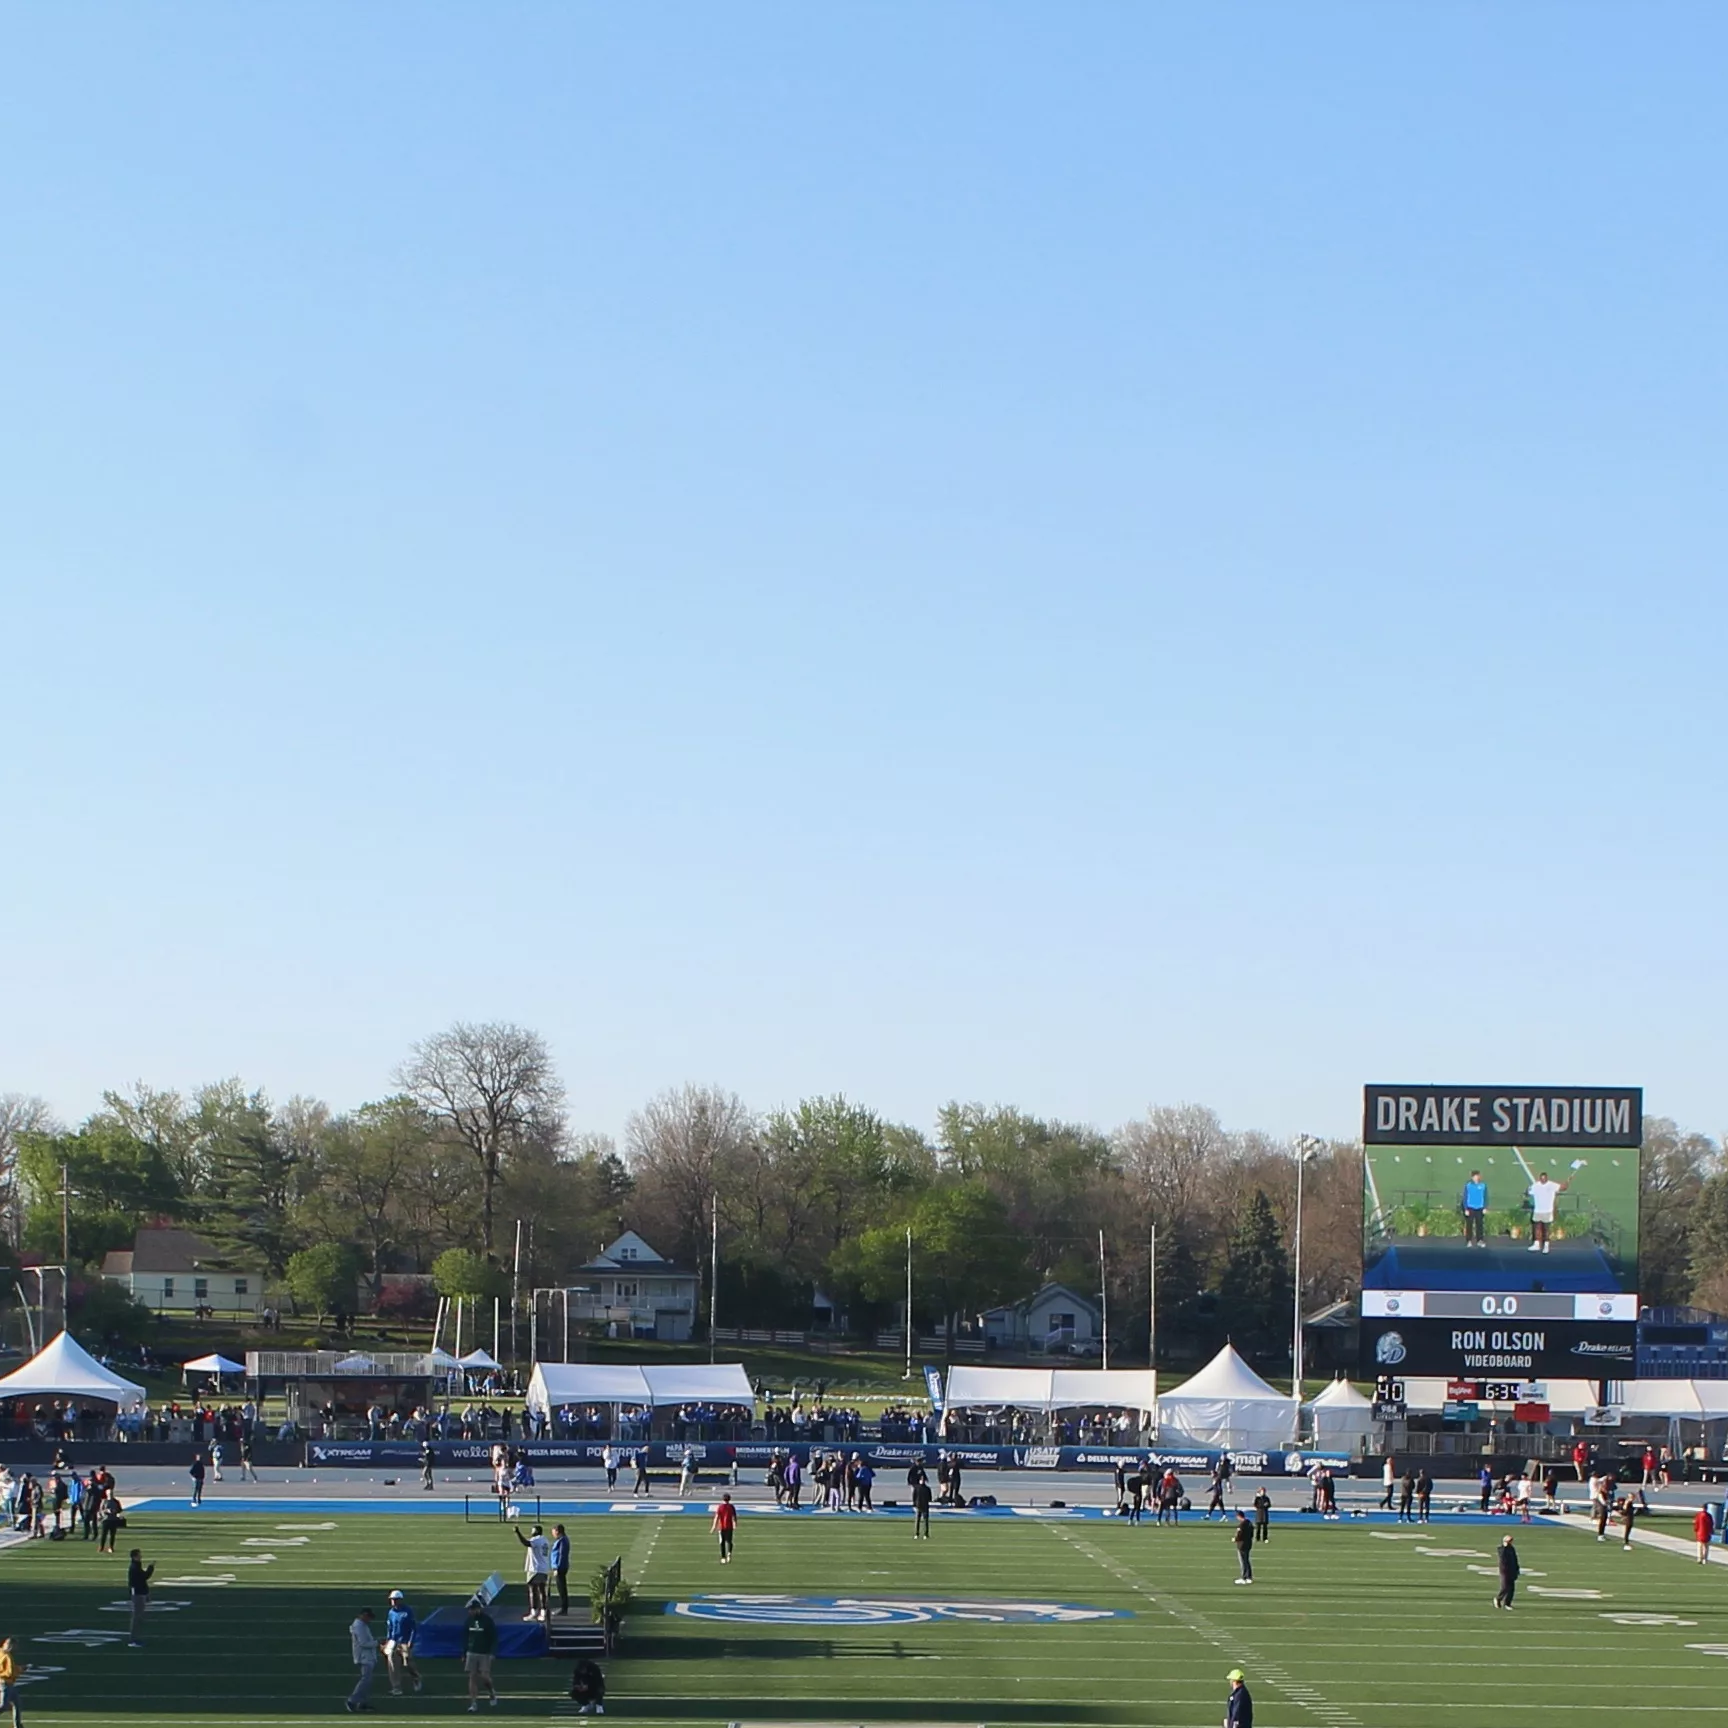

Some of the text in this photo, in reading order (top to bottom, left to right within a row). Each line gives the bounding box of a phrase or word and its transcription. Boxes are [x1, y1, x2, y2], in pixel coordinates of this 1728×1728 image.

[1376, 1096, 1630, 1134] DRAKE STADIUM
[1481, 1296, 1518, 1315] 0.0
[1451, 1331, 1545, 1351] RON OLSON
[1578, 1341, 1607, 1353] Drake
[1464, 1354, 1532, 1368] VIDEOBOARD
[1377, 1383, 1403, 1401] 40
[1485, 1384, 1520, 1400] 6:34
[1162, 1455, 1208, 1465] XTREAM
[1226, 1451, 1268, 1466] Smart
[1235, 1463, 1262, 1473] Honda
